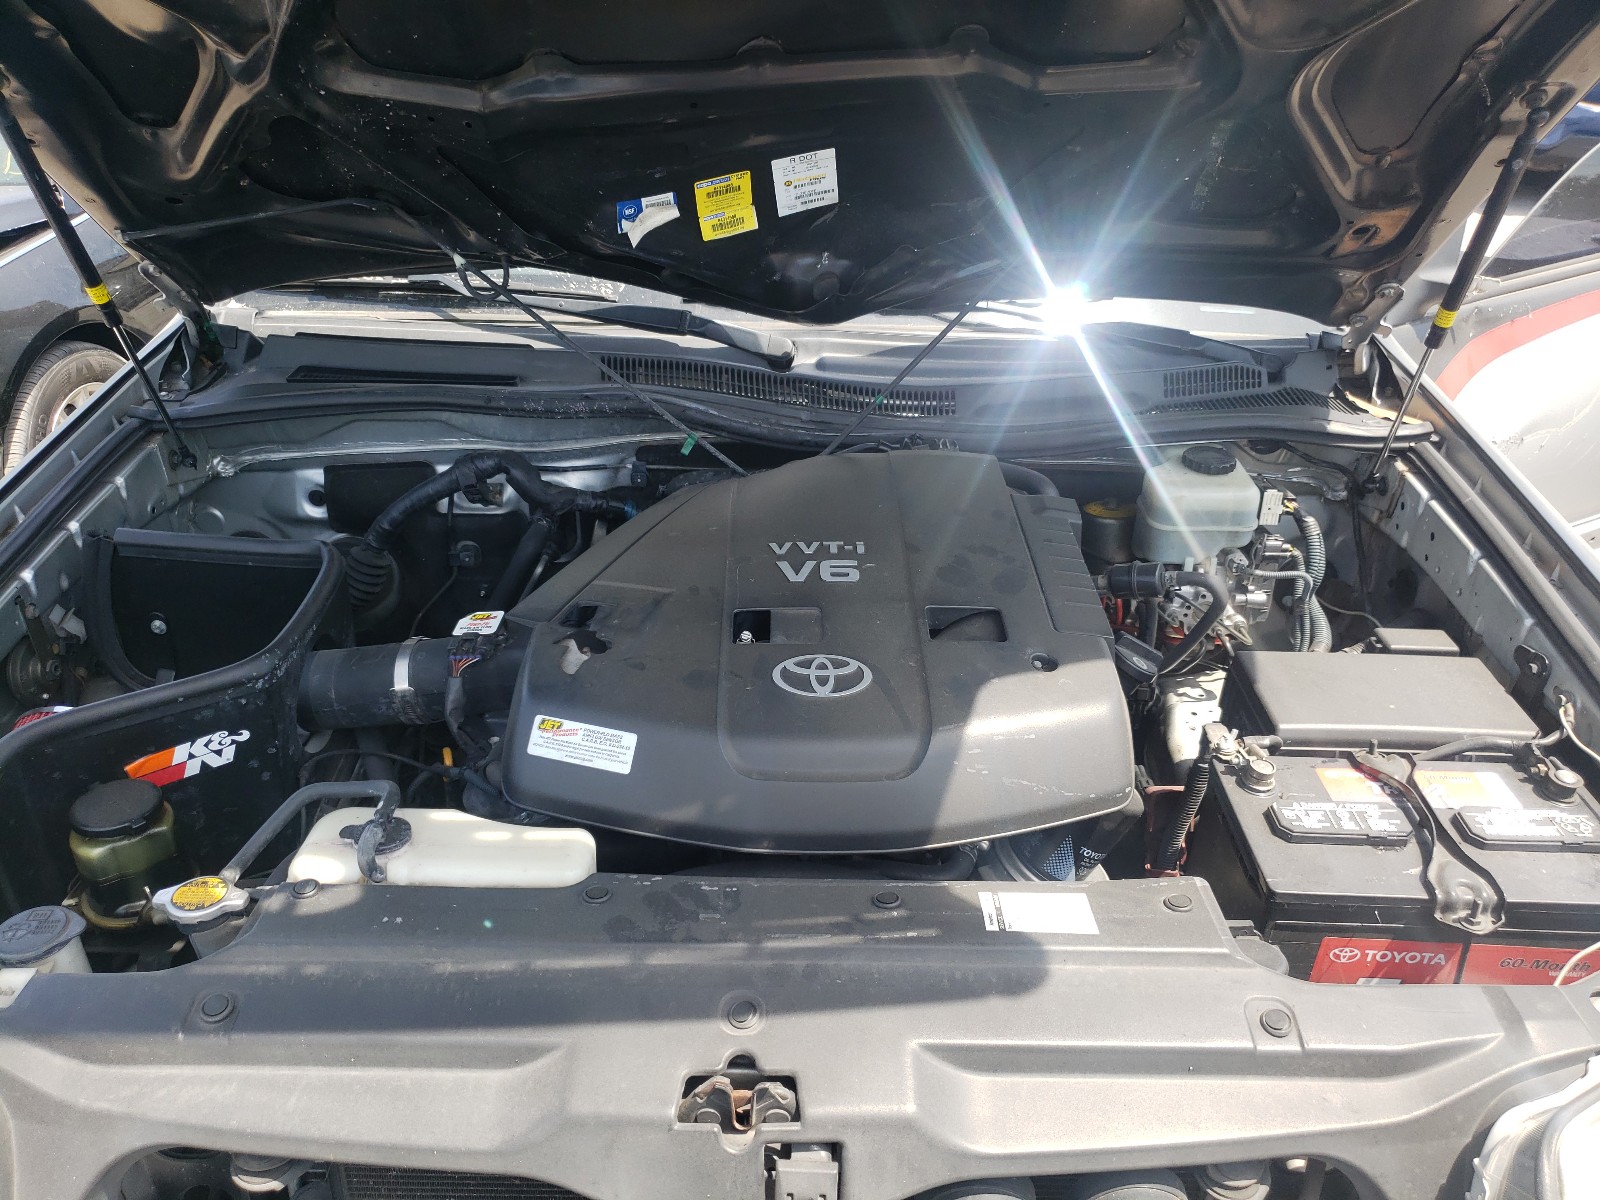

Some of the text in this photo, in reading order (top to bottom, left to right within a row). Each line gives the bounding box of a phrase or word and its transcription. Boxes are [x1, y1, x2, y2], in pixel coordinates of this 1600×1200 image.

[775, 559, 860, 583] V6
[539, 719, 563, 730] JET
[1364, 949, 1446, 966] TOYOTA
